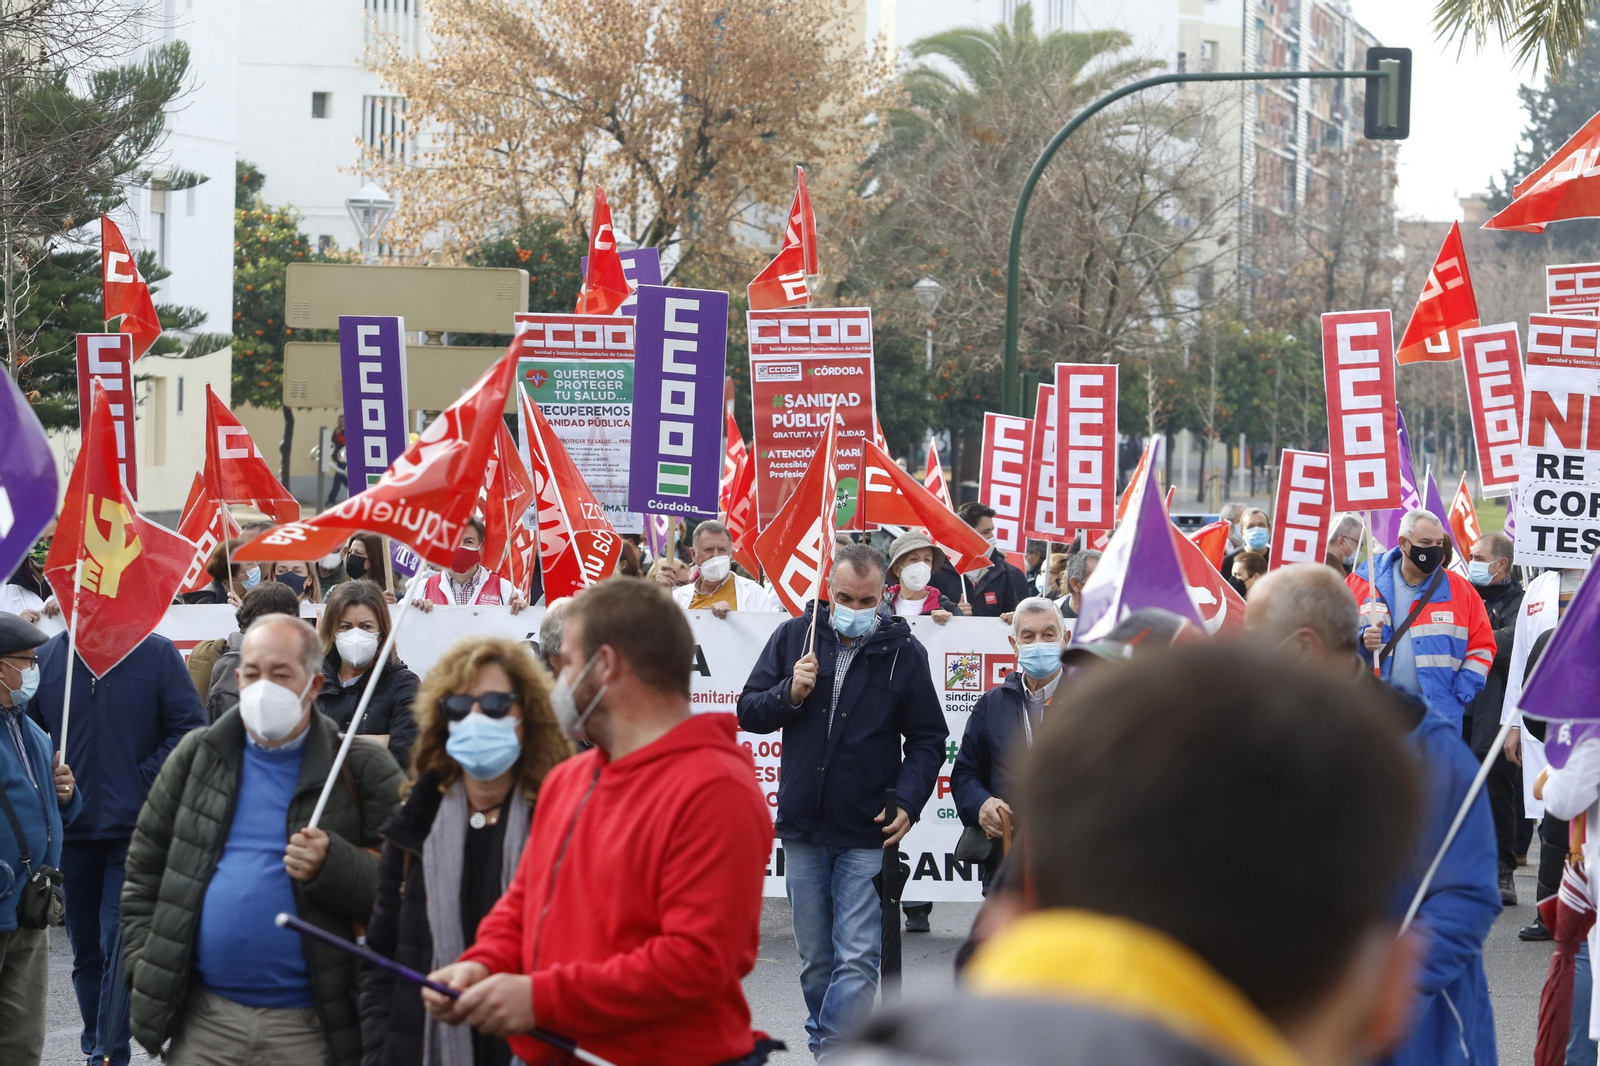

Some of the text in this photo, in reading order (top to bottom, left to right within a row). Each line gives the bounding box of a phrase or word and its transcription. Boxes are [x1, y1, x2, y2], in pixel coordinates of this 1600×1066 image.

[1549, 271, 1600, 297] CC
[515, 322, 634, 350] CCOO
[750, 318, 870, 344] CCOO
[1527, 324, 1600, 357] CC
[553, 369, 625, 380] QUEREMOS
[659, 297, 700, 457] CCOO
[807, 365, 864, 376] #CÓRDOBA
[357, 325, 389, 467] CCOO
[554, 391, 626, 401] TU SALUD...
[556, 380, 623, 390] PROTEGER
[772, 392, 861, 408] #SANIDAD
[1336, 321, 1389, 501] CCOO
[1474, 339, 1520, 478] CCOO
[548, 417, 631, 428] ANIDAD PÚBLICA
[773, 431, 812, 439] GRATUITA
[837, 429, 866, 437] ALIDAD
[1067, 374, 1104, 522] CCOO
[769, 461, 808, 469] Accesible
[990, 417, 1025, 551] CCOO
[647, 500, 699, 513] Córdoba
[1280, 453, 1328, 567] CCO
